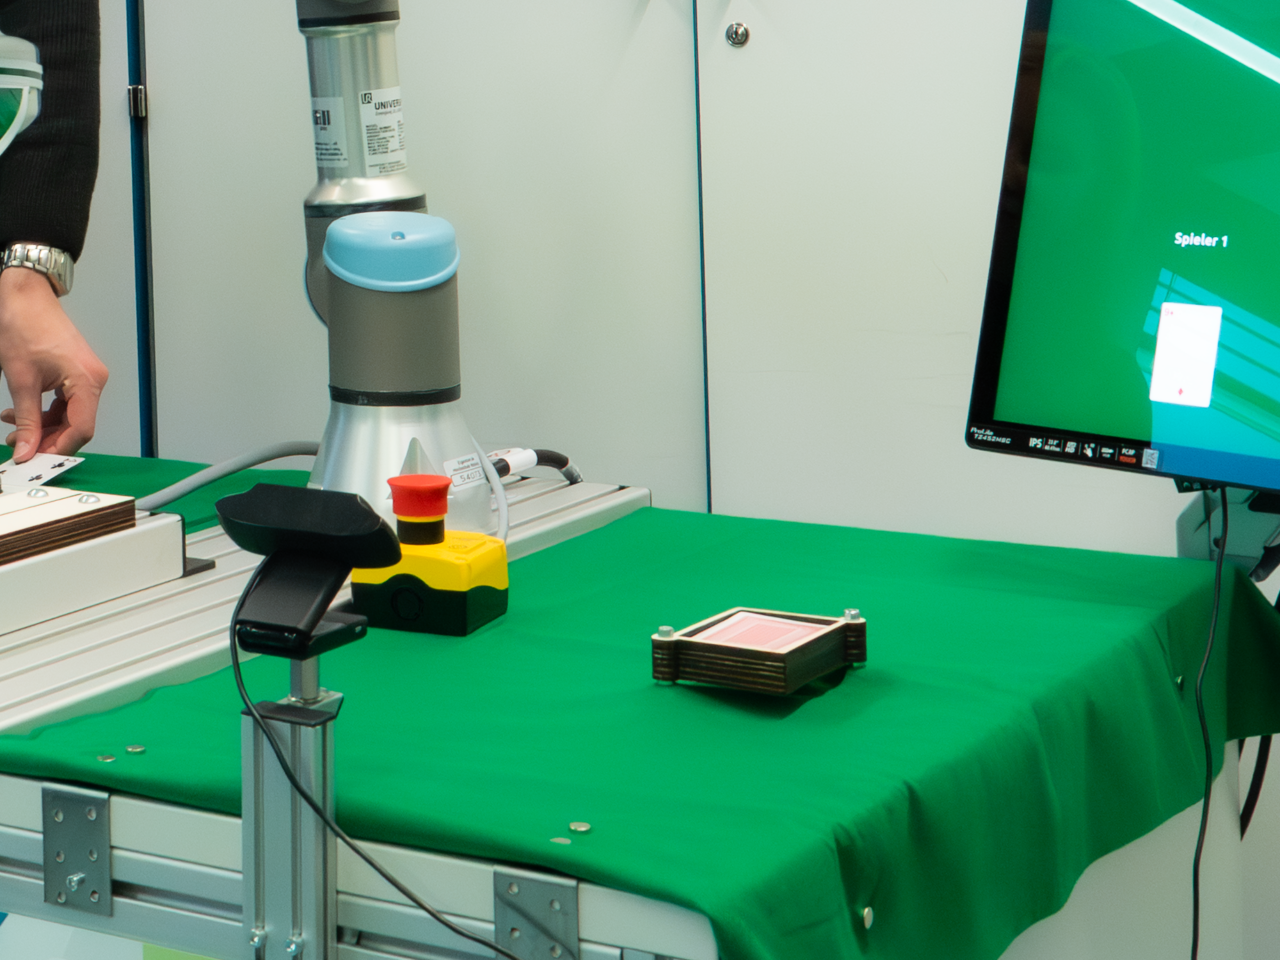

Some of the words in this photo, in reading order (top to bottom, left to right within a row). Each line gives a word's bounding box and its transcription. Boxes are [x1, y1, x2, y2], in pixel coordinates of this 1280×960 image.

[1174, 231, 1219, 248] Spieler
[1221, 234, 1229, 248] 1
[1028, 437, 1043, 449] IPS
